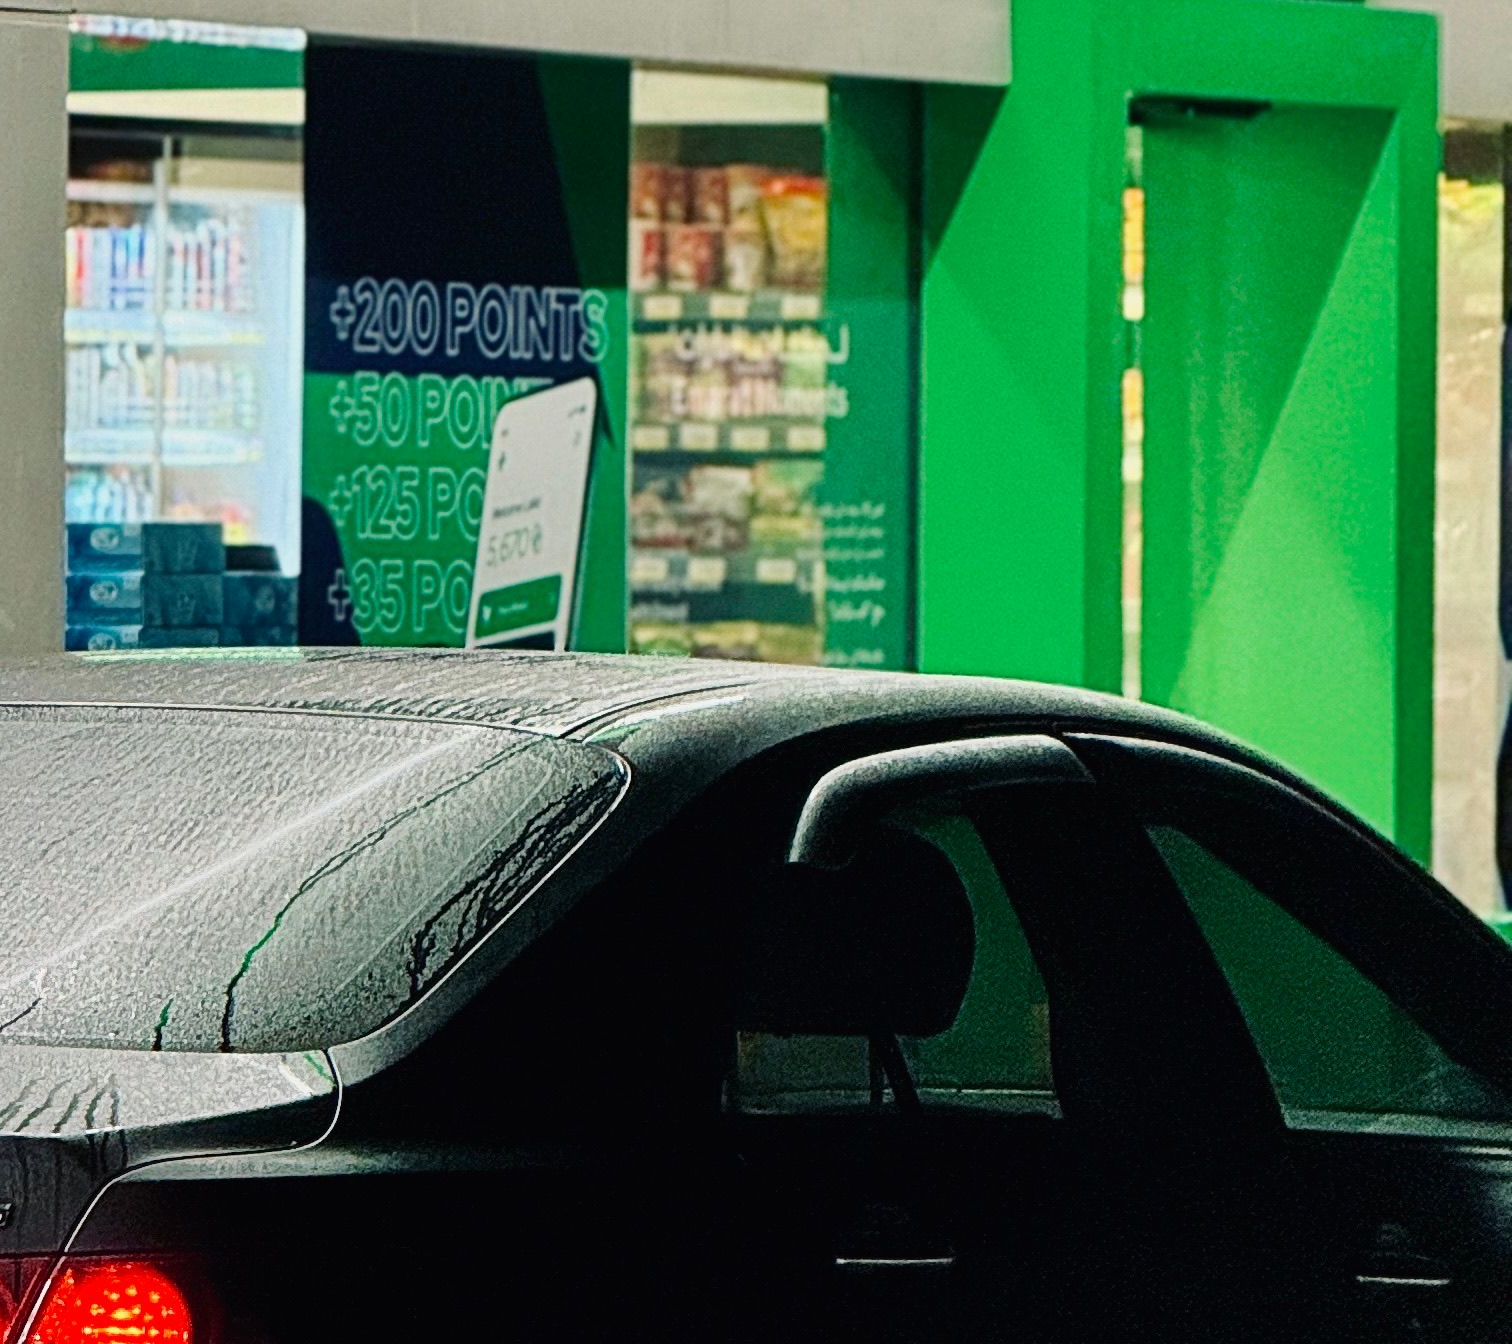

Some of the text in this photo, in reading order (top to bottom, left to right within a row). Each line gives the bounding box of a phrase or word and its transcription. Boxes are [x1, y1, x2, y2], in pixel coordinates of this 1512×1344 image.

[329, 276, 439, 355] +200
[445, 281, 609, 362] POINTS
[329, 370, 411, 448] +50
[329, 464, 419, 541] +125
[326, 558, 405, 633] +35
